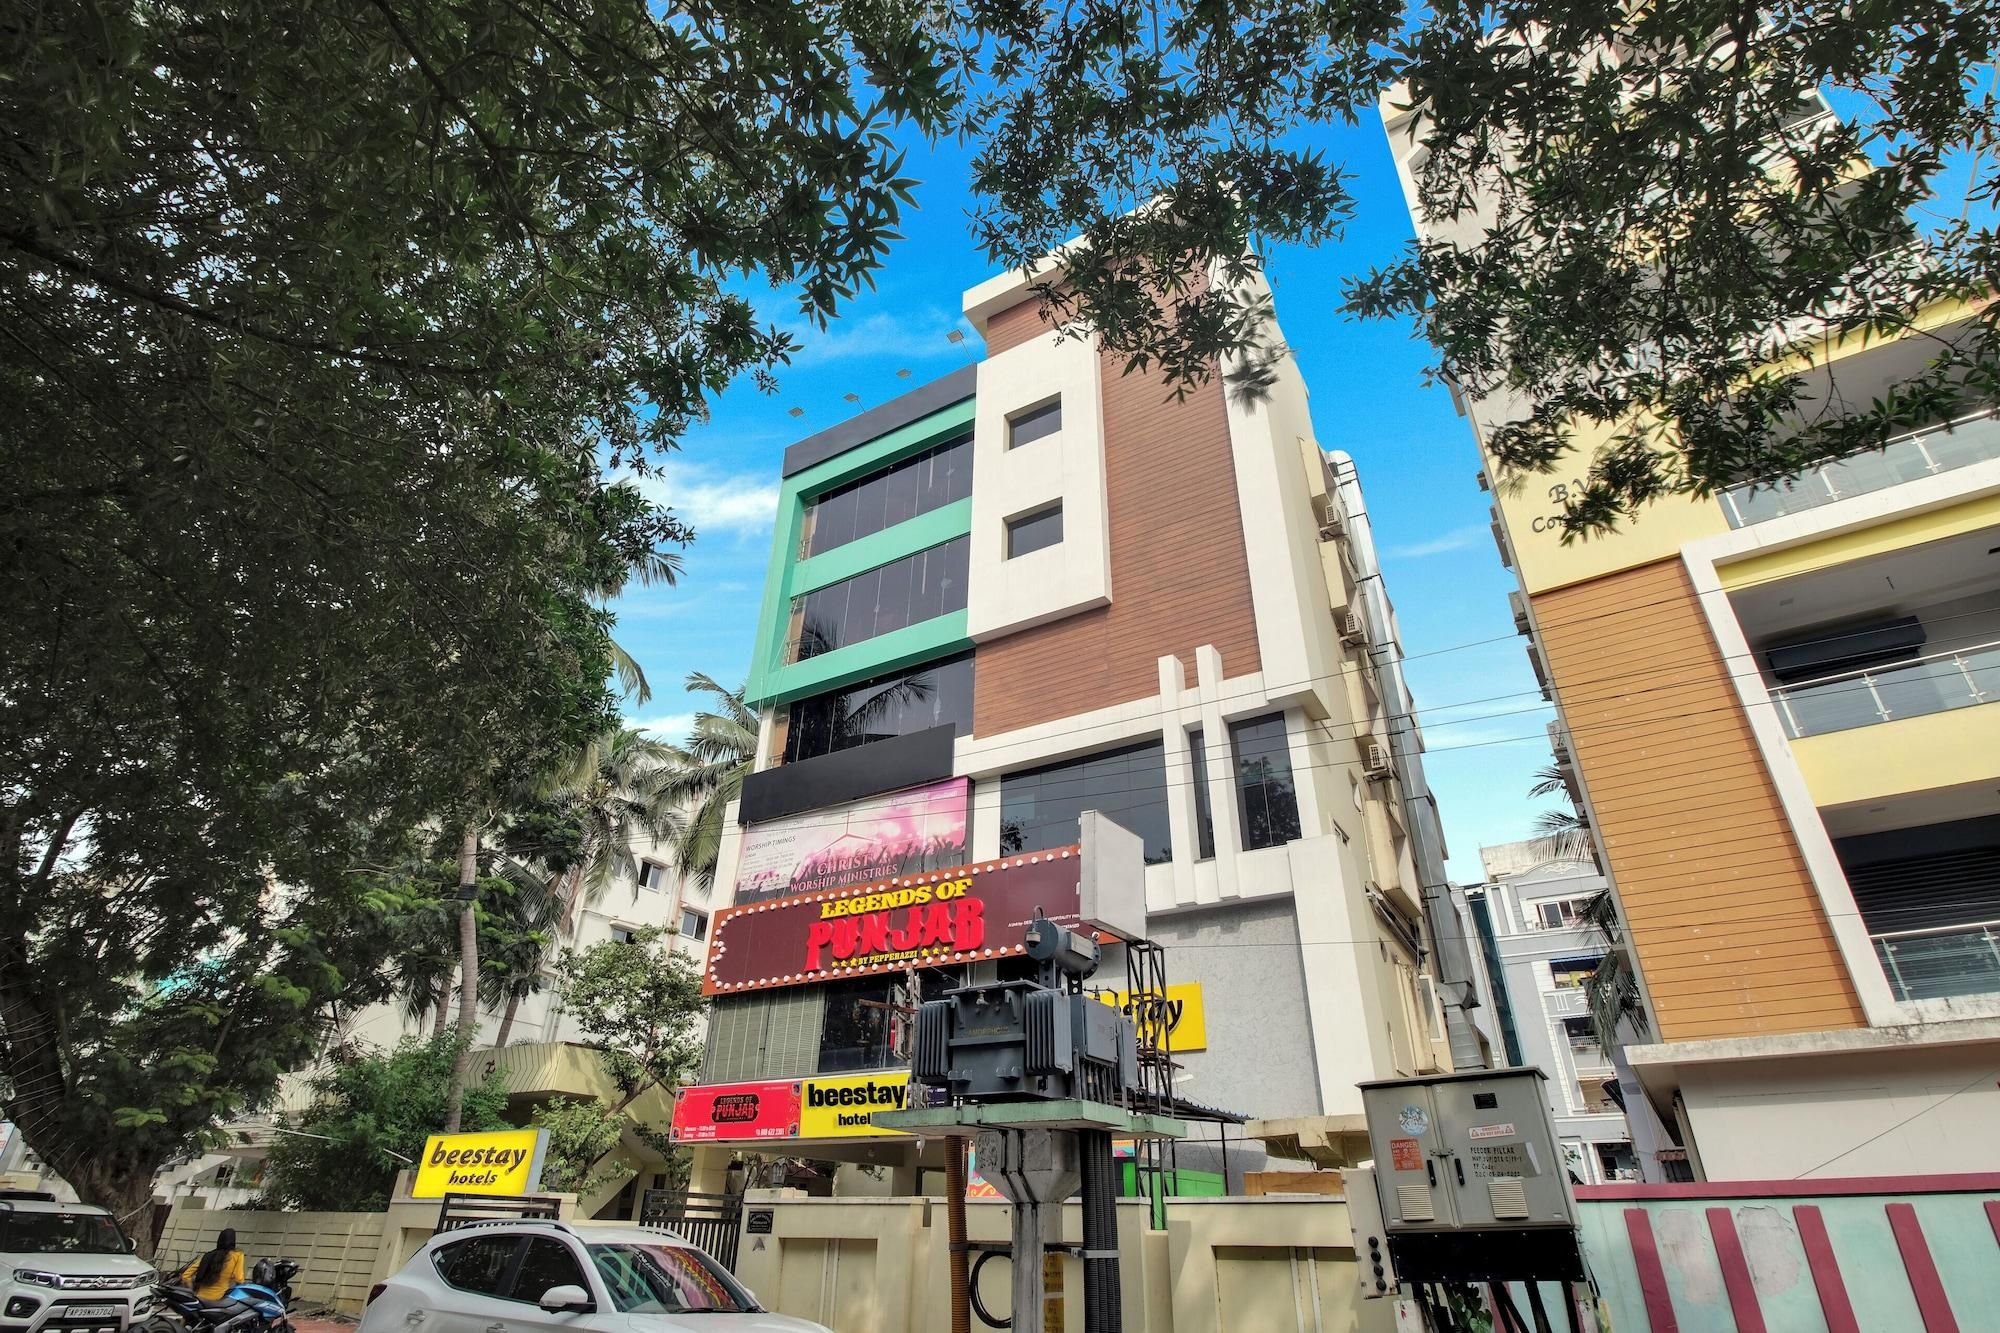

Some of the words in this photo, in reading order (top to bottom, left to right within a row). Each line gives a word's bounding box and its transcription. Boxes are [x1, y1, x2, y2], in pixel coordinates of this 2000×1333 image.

[746, 841, 772, 851] WORSHIP
[772, 835, 796, 846] TIMINGS
[817, 853, 871, 876] CHRIST
[790, 876, 836, 893] WORSHIP
[838, 863, 898, 886] MINISTRIES
[820, 884, 933, 919] LEGENDS
[935, 878, 973, 900] OF
[804, 897, 985, 972] PUNJAB
[858, 957, 869, 965] BY
[720, 1096, 744, 1105] LEGENDS
[808, 1082, 906, 1109] beestay
[716, 1103, 755, 1120] PUNJAB
[838, 1112, 871, 1126] hotel
[1391, 1141, 1417, 1149] DANGER
[1493, 1147, 1515, 1155] PILLAR
[430, 1141, 527, 1173] beestay
[449, 1170, 498, 1184] hotels
